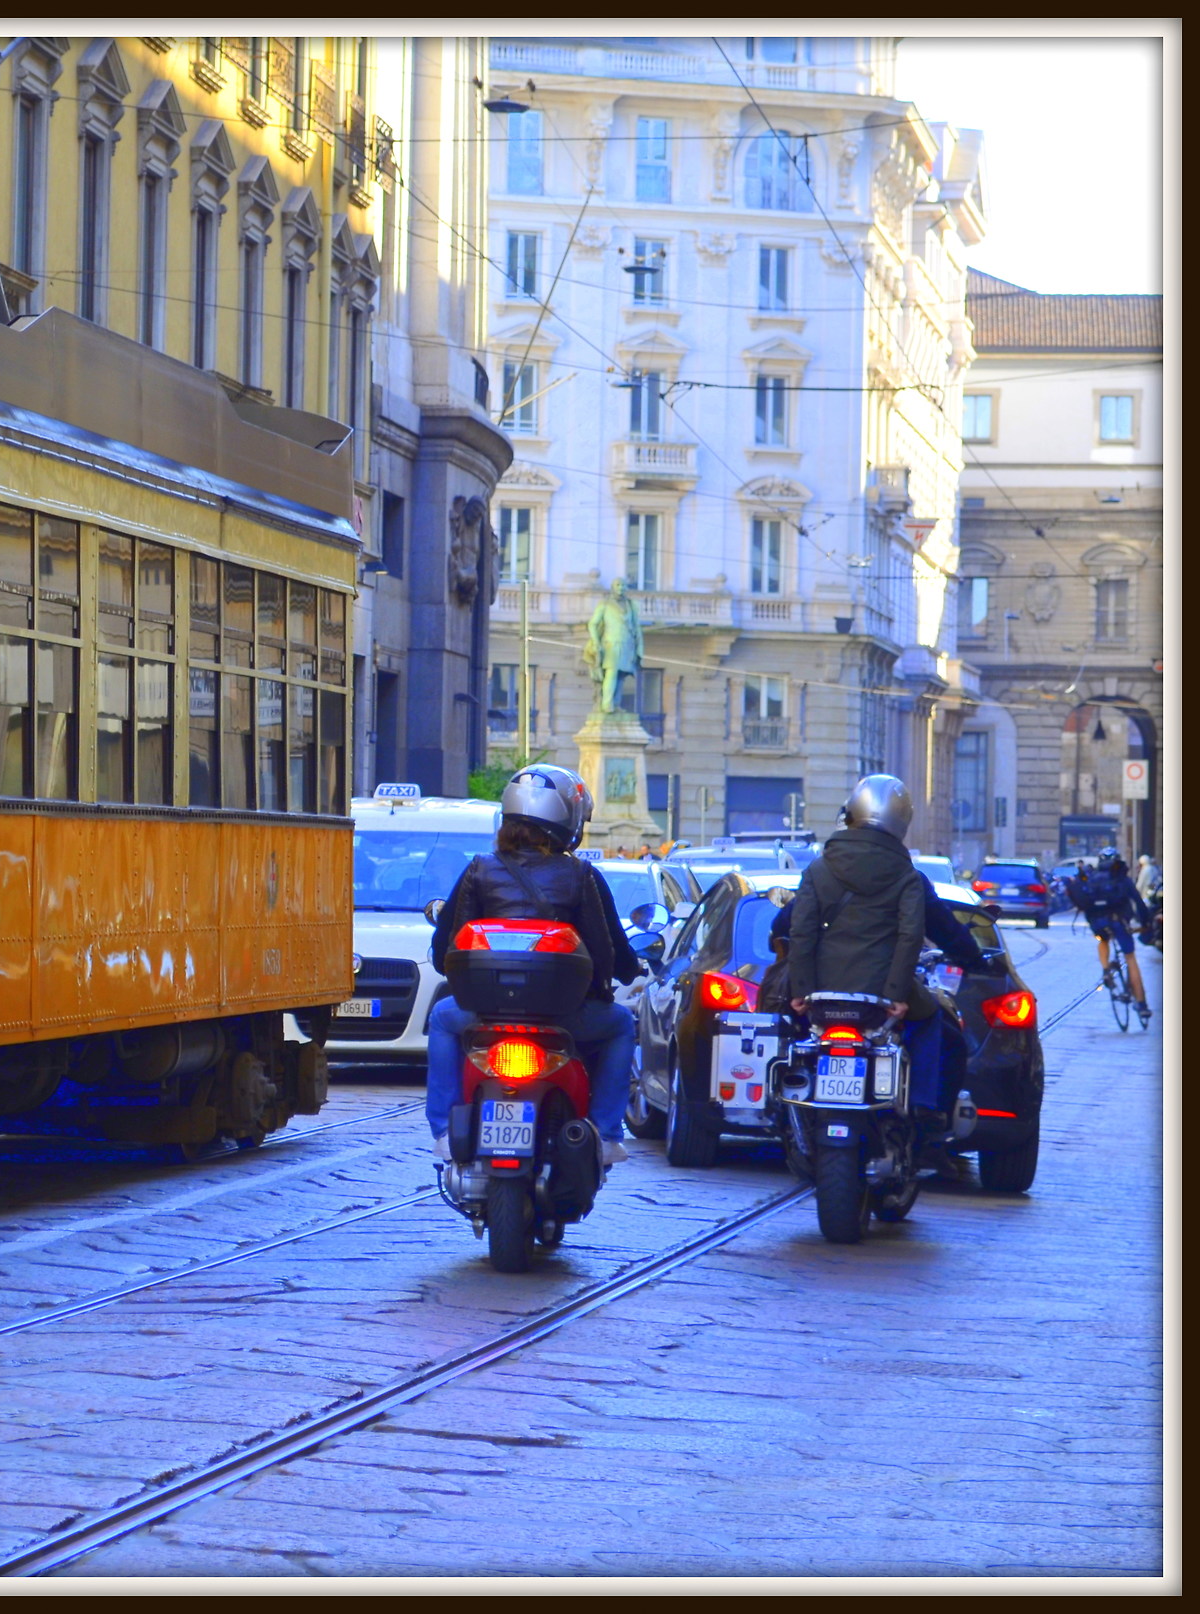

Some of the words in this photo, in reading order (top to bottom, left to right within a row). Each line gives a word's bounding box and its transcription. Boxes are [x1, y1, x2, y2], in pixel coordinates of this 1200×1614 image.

[380, 786, 415, 796] TAXI
[830, 1058, 847, 1075] DR
[820, 1079, 862, 1096] 15046
[495, 1103, 514, 1121] DS
[482, 1126, 532, 1144] 31870
